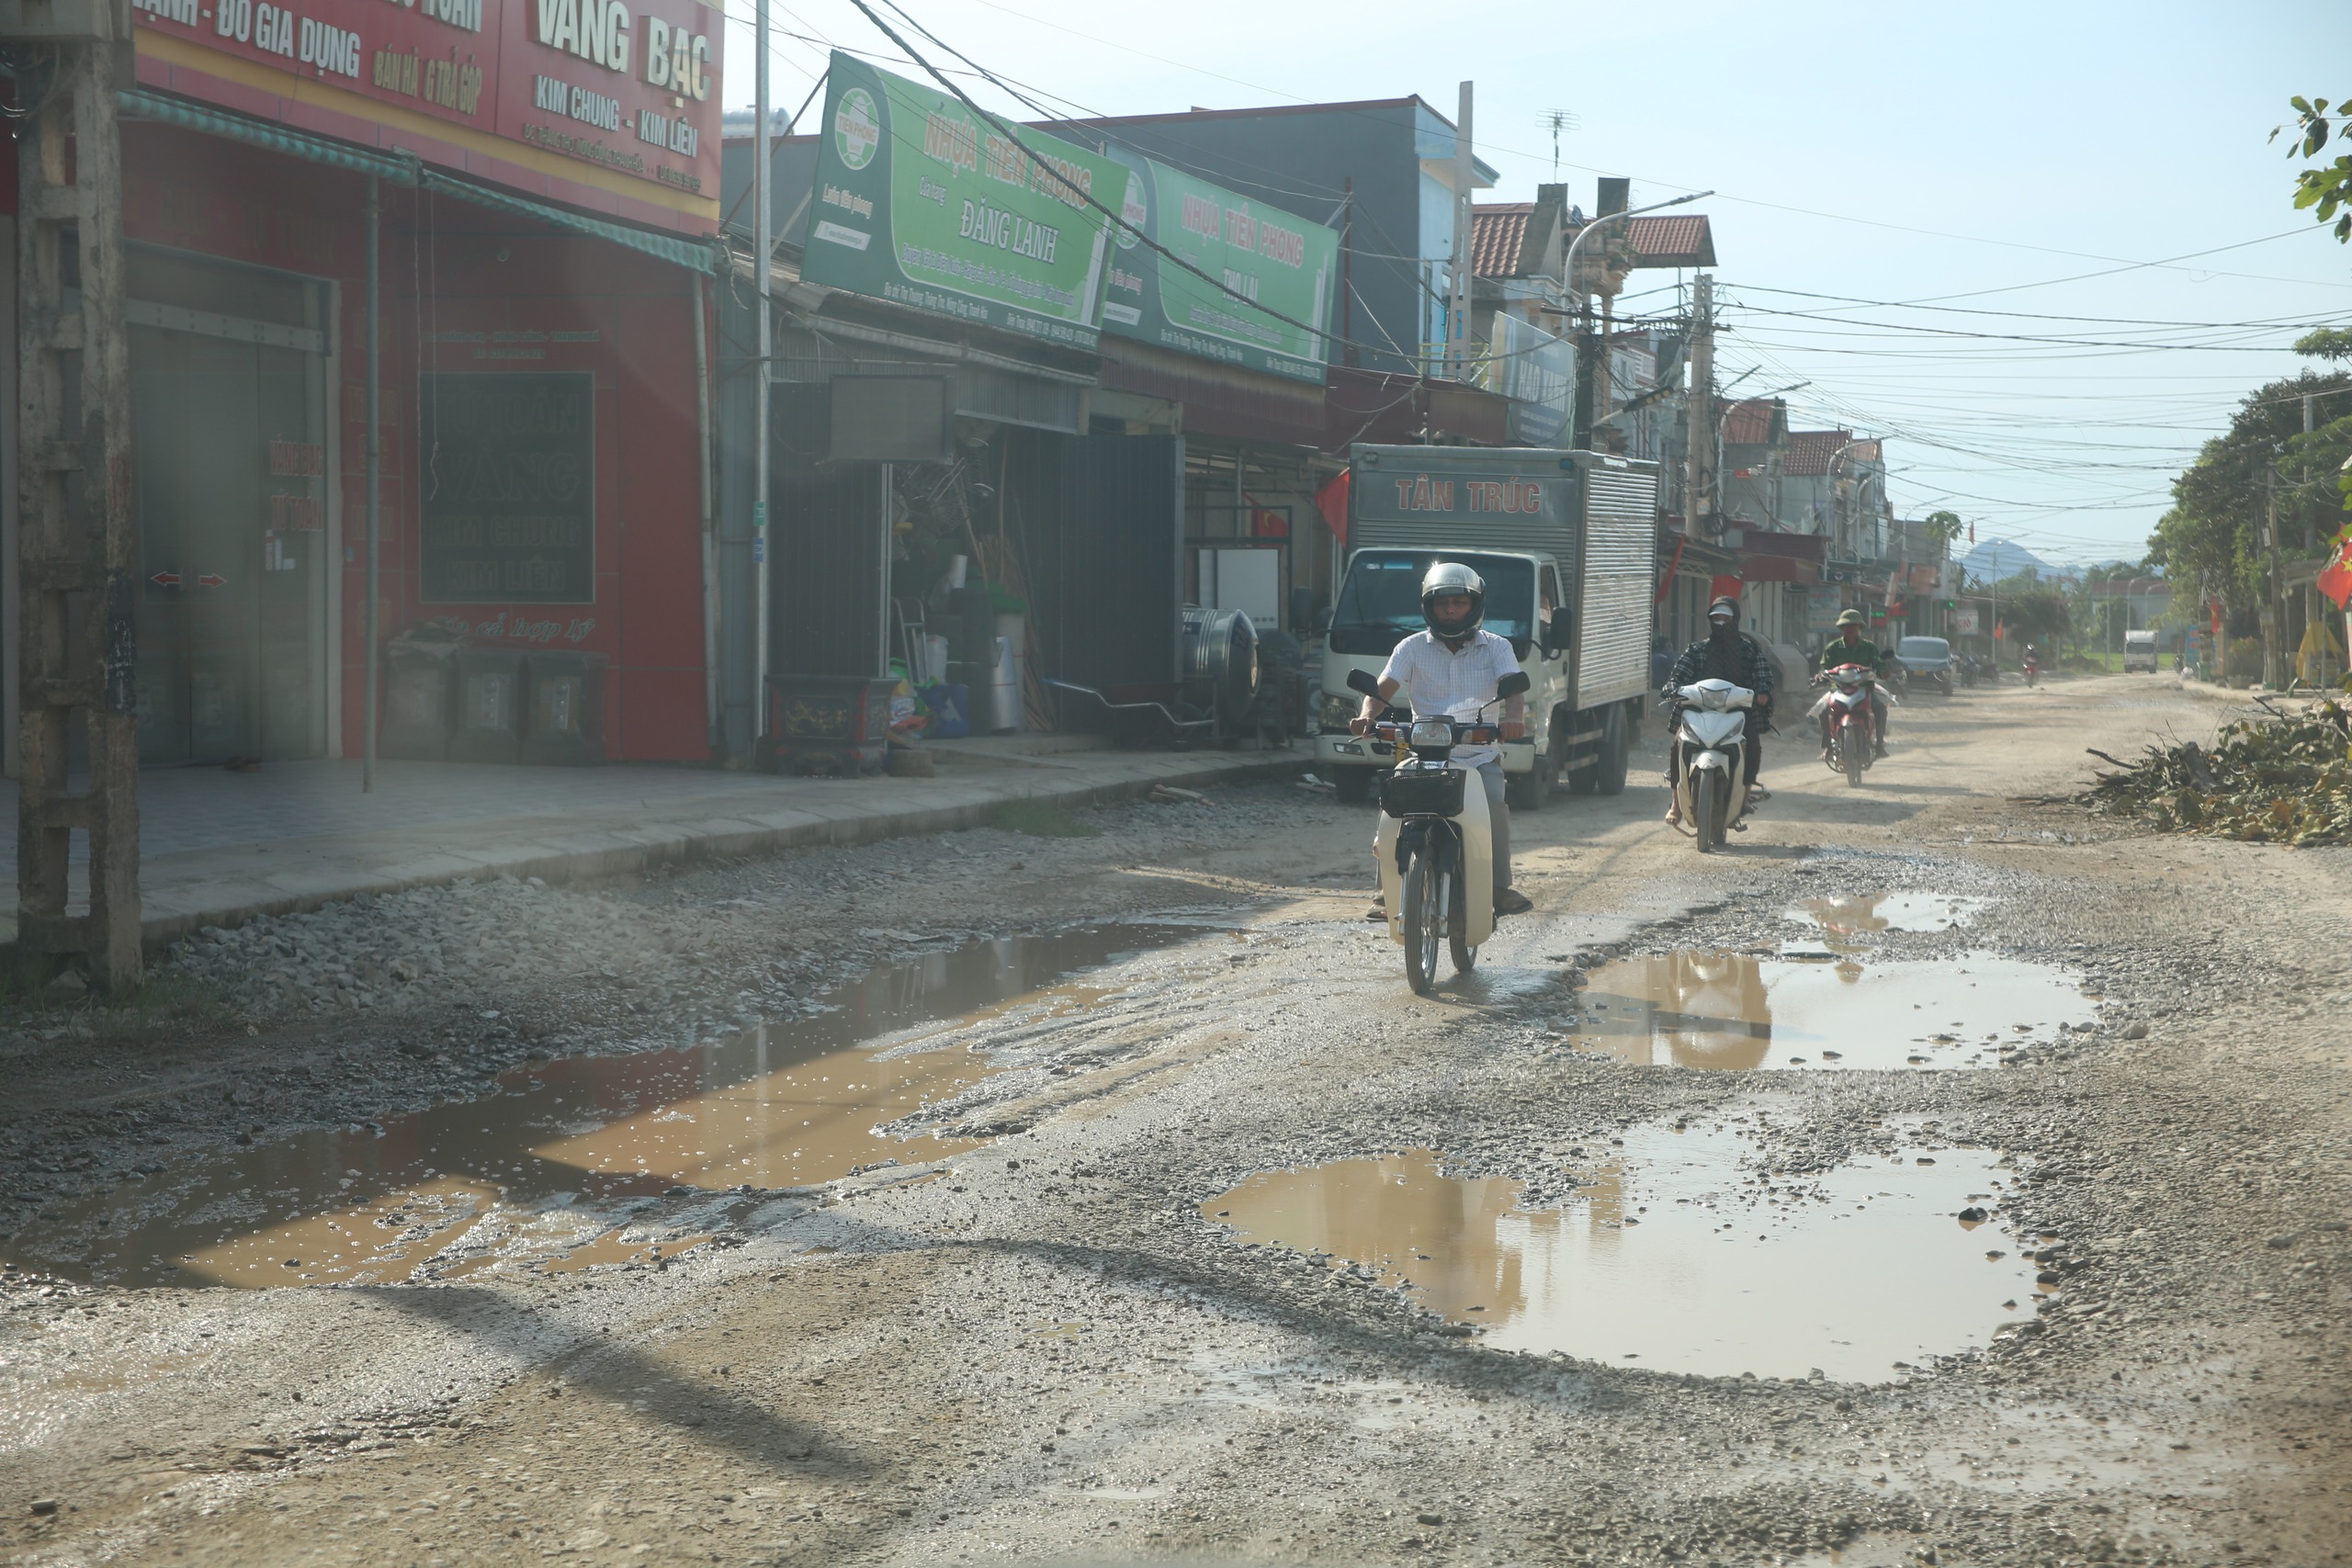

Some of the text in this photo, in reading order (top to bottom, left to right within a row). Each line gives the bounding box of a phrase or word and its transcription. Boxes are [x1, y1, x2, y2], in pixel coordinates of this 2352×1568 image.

[255, 2, 293, 57] GIA
[300, 17, 361, 78] DỤNG
[646, 16, 711, 107] BẠC
[374, 43, 401, 92] BÁN
[459, 54, 482, 115] GÓP
[536, 73, 568, 115] KIM
[571, 85, 619, 132] CHUNG
[639, 109, 667, 147] KIM
[670, 117, 697, 159] LIÊN
[923, 110, 977, 178] NHỰA
[1030, 150, 1091, 210] PHONG
[959, 192, 1010, 249] ĐĂNG
[1182, 191, 1220, 247] NHỰA
[1259, 220, 1305, 268] PHONG
[435, 439, 581, 502] VÀNG
[1396, 473, 1541, 513] TÂN TRÚC
[425, 513, 482, 547] KIM
[490, 513, 582, 547] CHUNG
[447, 553, 566, 592] KIM LIÊN
[477, 612, 507, 637] cả
[509, 616, 561, 643] hợp
[563, 617, 595, 643] lý
